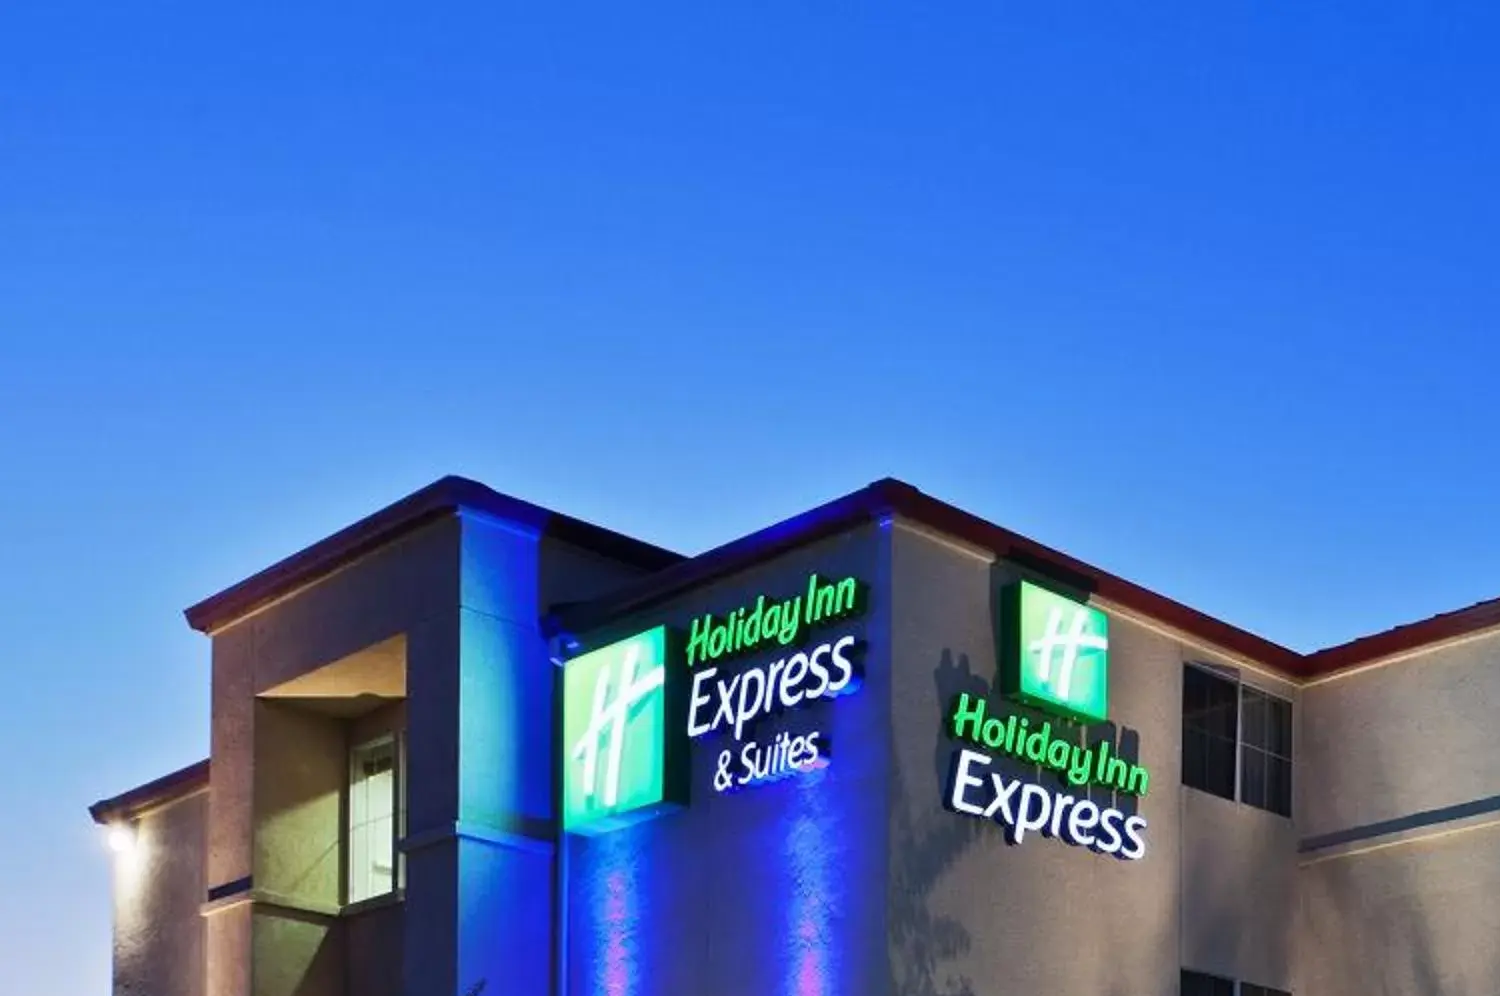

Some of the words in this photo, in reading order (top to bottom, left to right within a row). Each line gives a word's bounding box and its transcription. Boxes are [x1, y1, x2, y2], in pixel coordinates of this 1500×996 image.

[686, 595, 802, 667] Holiday
[805, 574, 856, 625] Inn
[687, 635, 855, 741] Express
[713, 749, 734, 792] &
[738, 730, 820, 785] Suites
[953, 693, 1093, 785] Holiday
[1097, 739, 1150, 796] Inn
[952, 748, 1148, 860] Express
